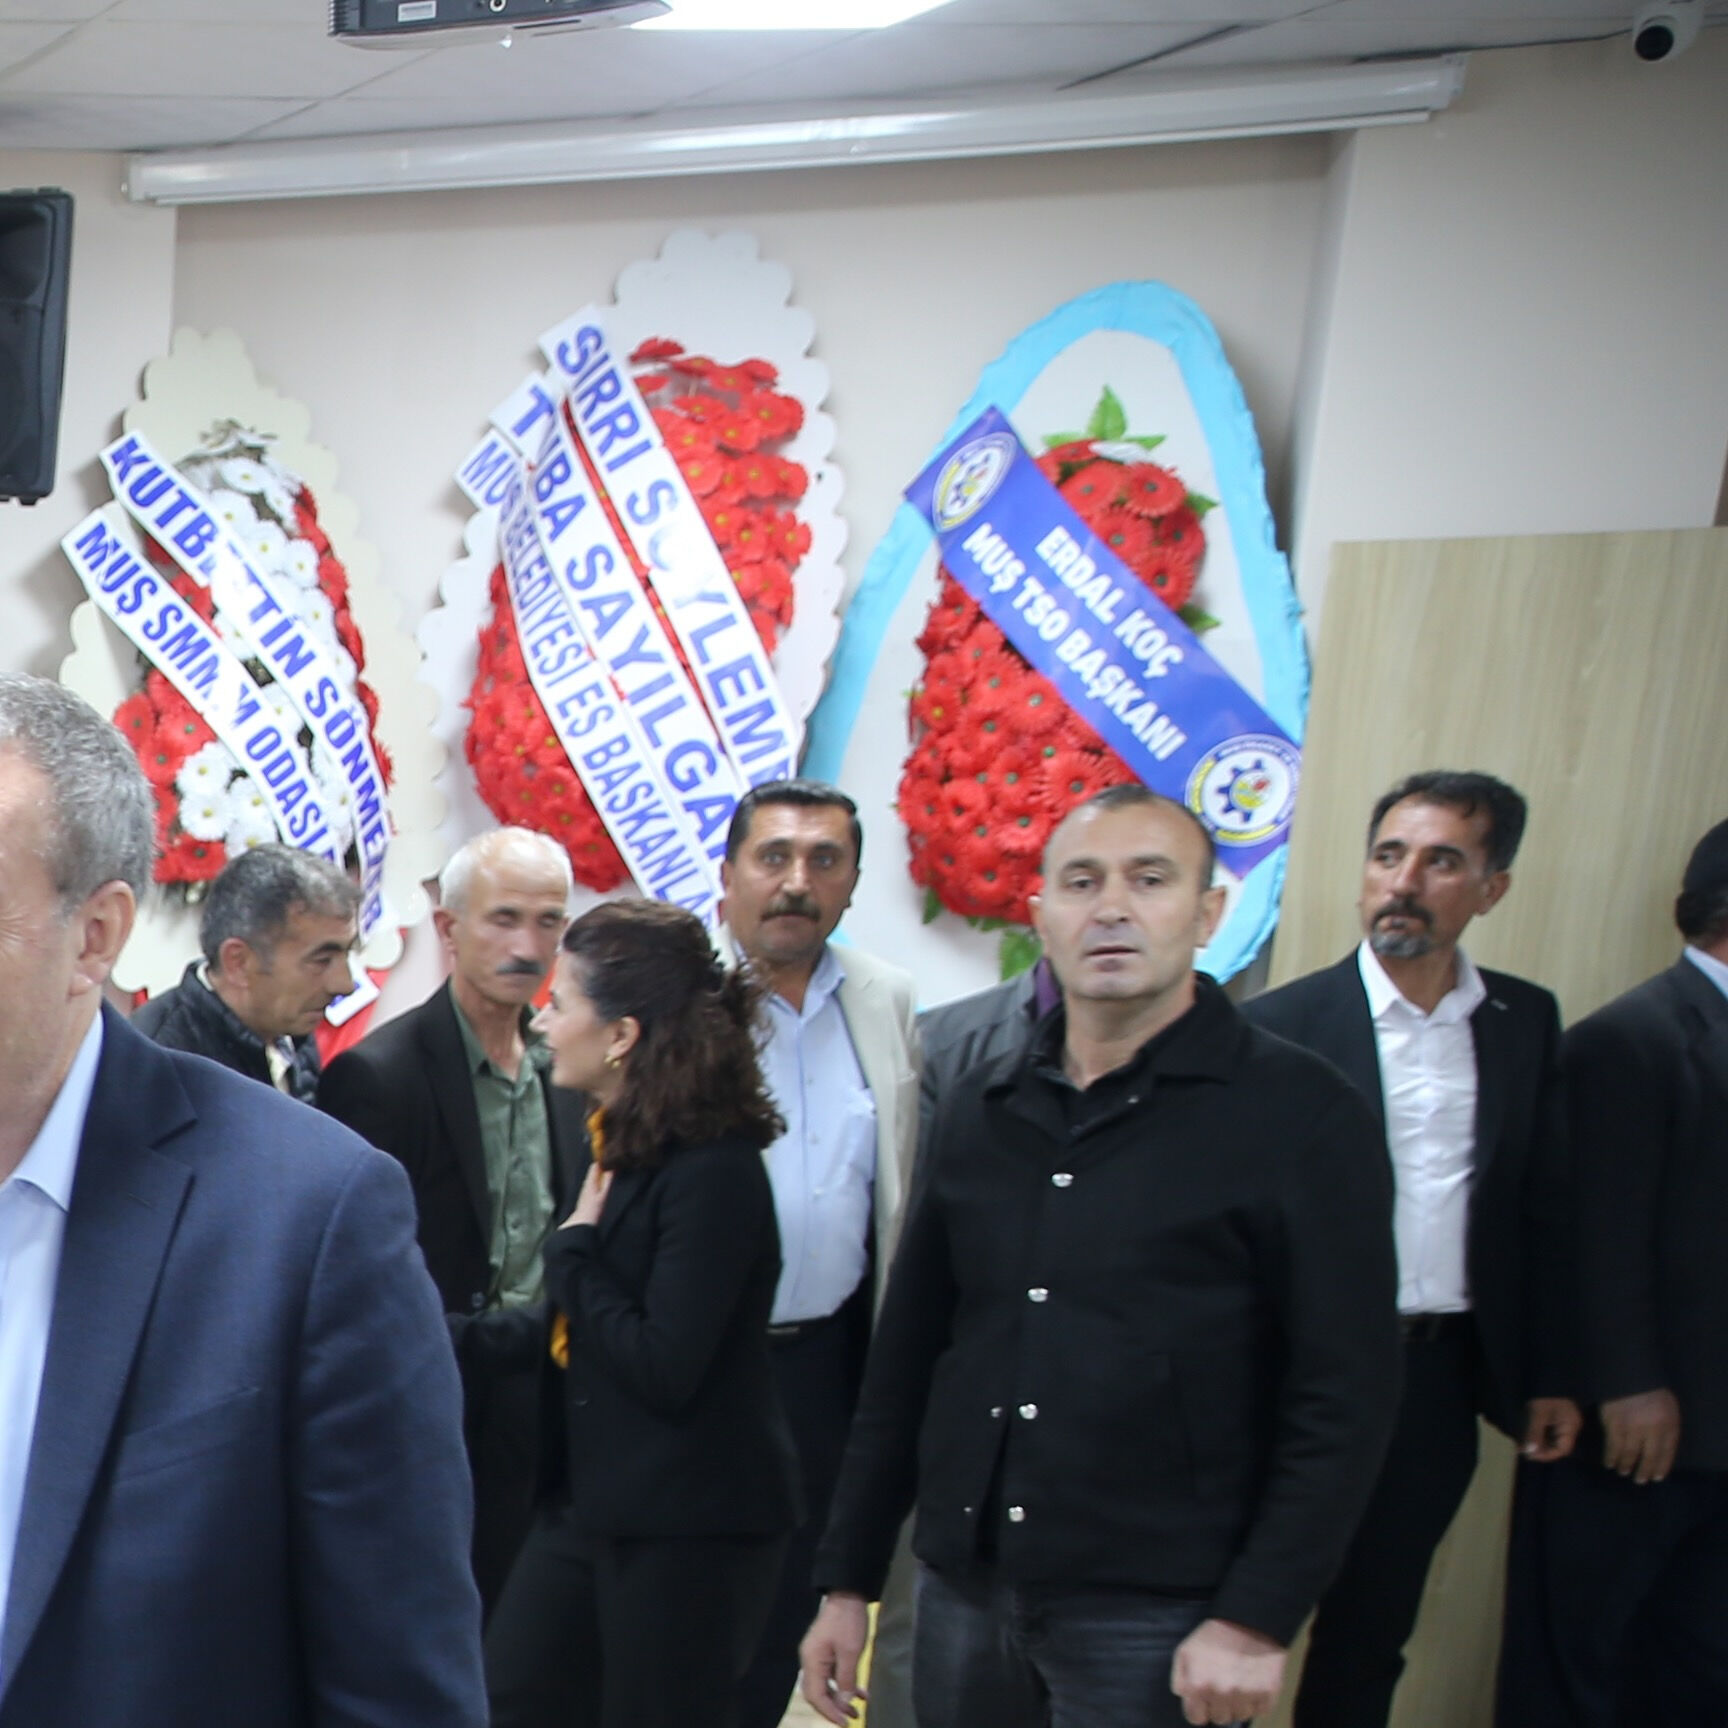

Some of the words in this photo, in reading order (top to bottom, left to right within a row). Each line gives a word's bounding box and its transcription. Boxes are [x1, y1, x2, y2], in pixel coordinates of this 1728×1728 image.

[556, 325, 654, 474] SIRRI
[74, 521, 159, 616] MUŞ
[244, 724, 330, 853] ODASI
[960, 521, 1028, 594] MUŞ
[1011, 575, 1072, 643] TSO
[1055, 628, 1188, 763] BAŞKANI
[1034, 524, 1130, 625] ERDAL
[1113, 606, 1185, 681] KOÇ
